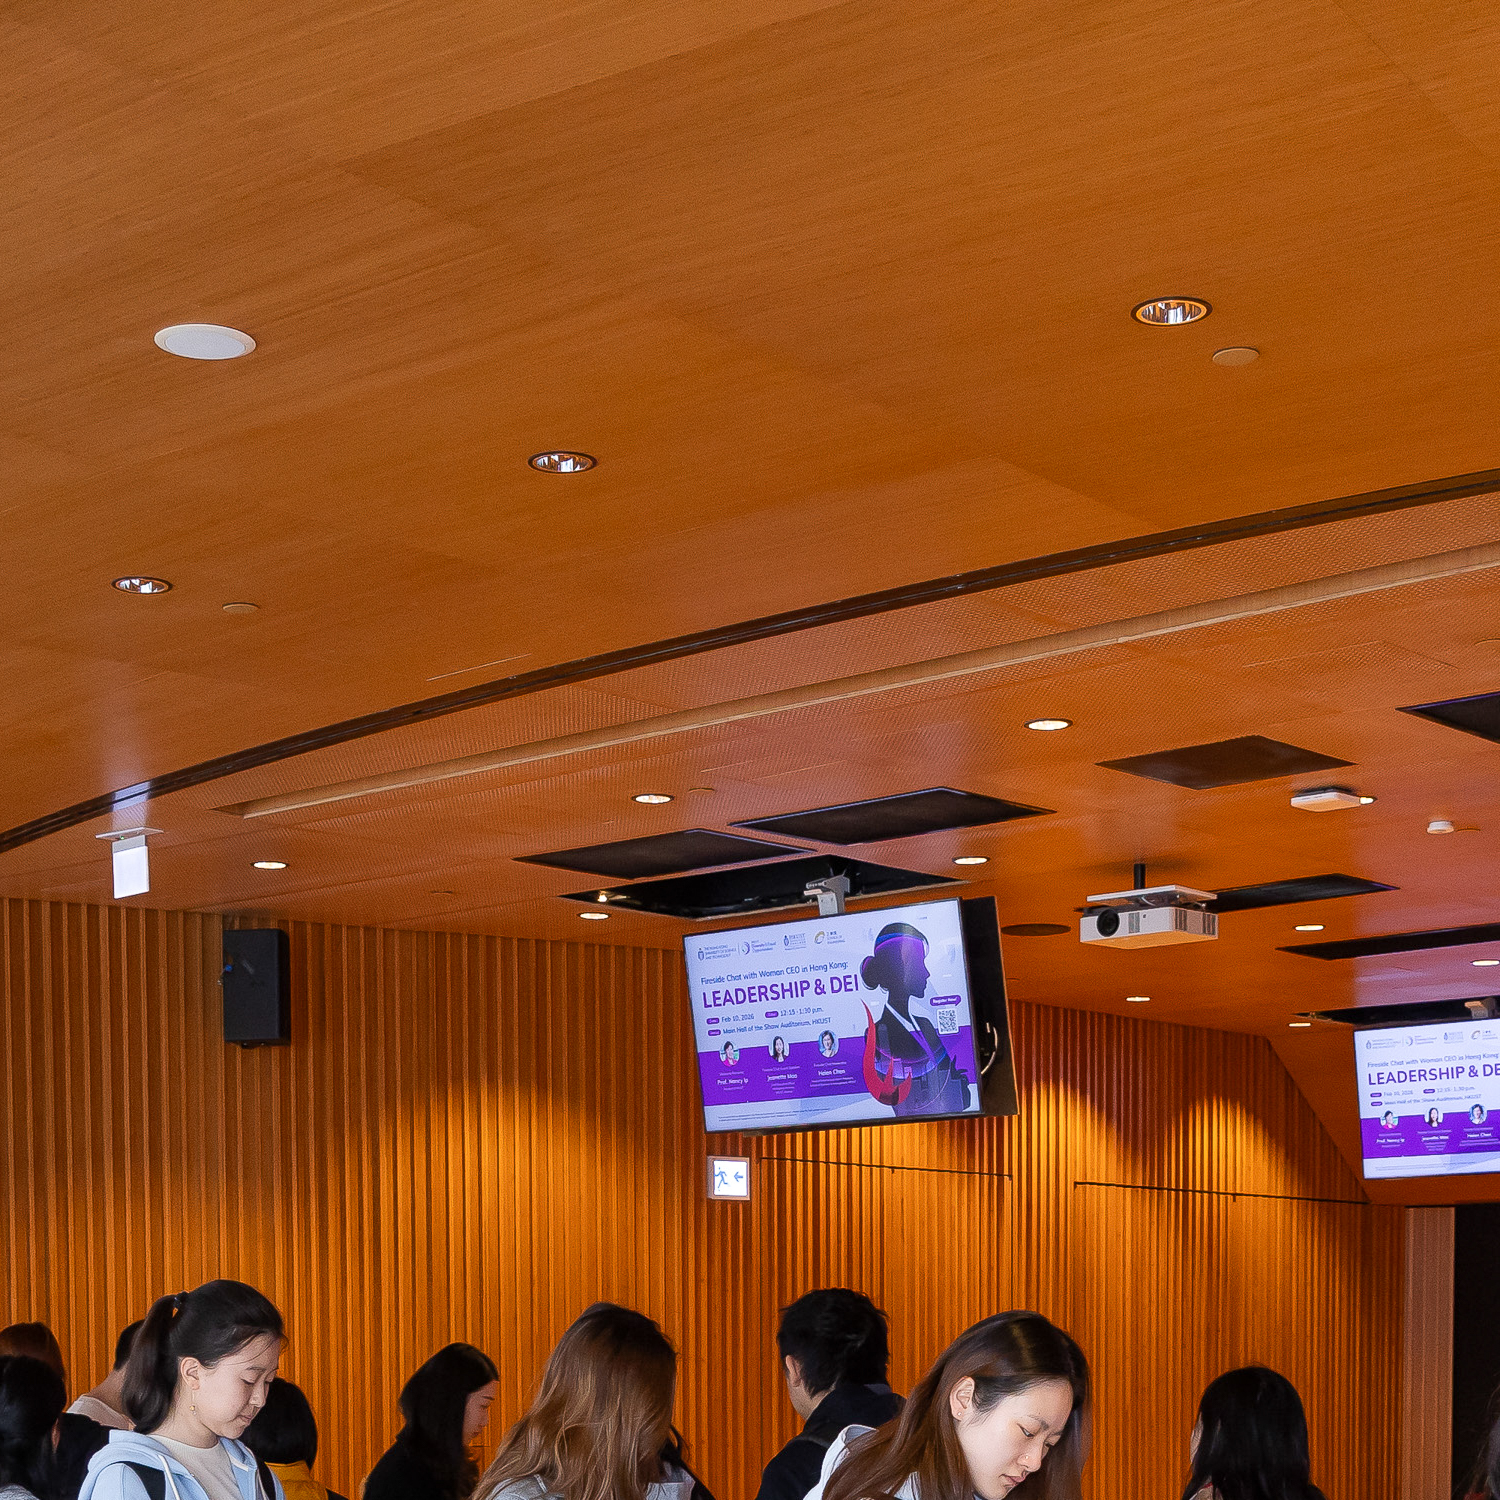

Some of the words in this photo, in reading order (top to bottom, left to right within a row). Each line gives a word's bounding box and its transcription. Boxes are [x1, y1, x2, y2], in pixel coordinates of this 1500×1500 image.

[700, 976, 726, 986] Fireside
[726, 973, 742, 982] Chat
[743, 970, 758, 980] with
[758, 969, 785, 978] Woman
[785, 965, 800, 975] CEO
[801, 965, 808, 973] in
[809, 963, 828, 973] Hong
[828, 961, 849, 970] Kong:
[702, 980, 811, 1009] LEADERSHIP
[813, 978, 827, 996] &
[829, 974, 859, 994] DEI
[721, 1016, 731, 1024] Feb
[754, 1023, 763, 1031] the
[1368, 1066, 1465, 1085] LEADERSHIP
[1468, 1064, 1479, 1078] &
